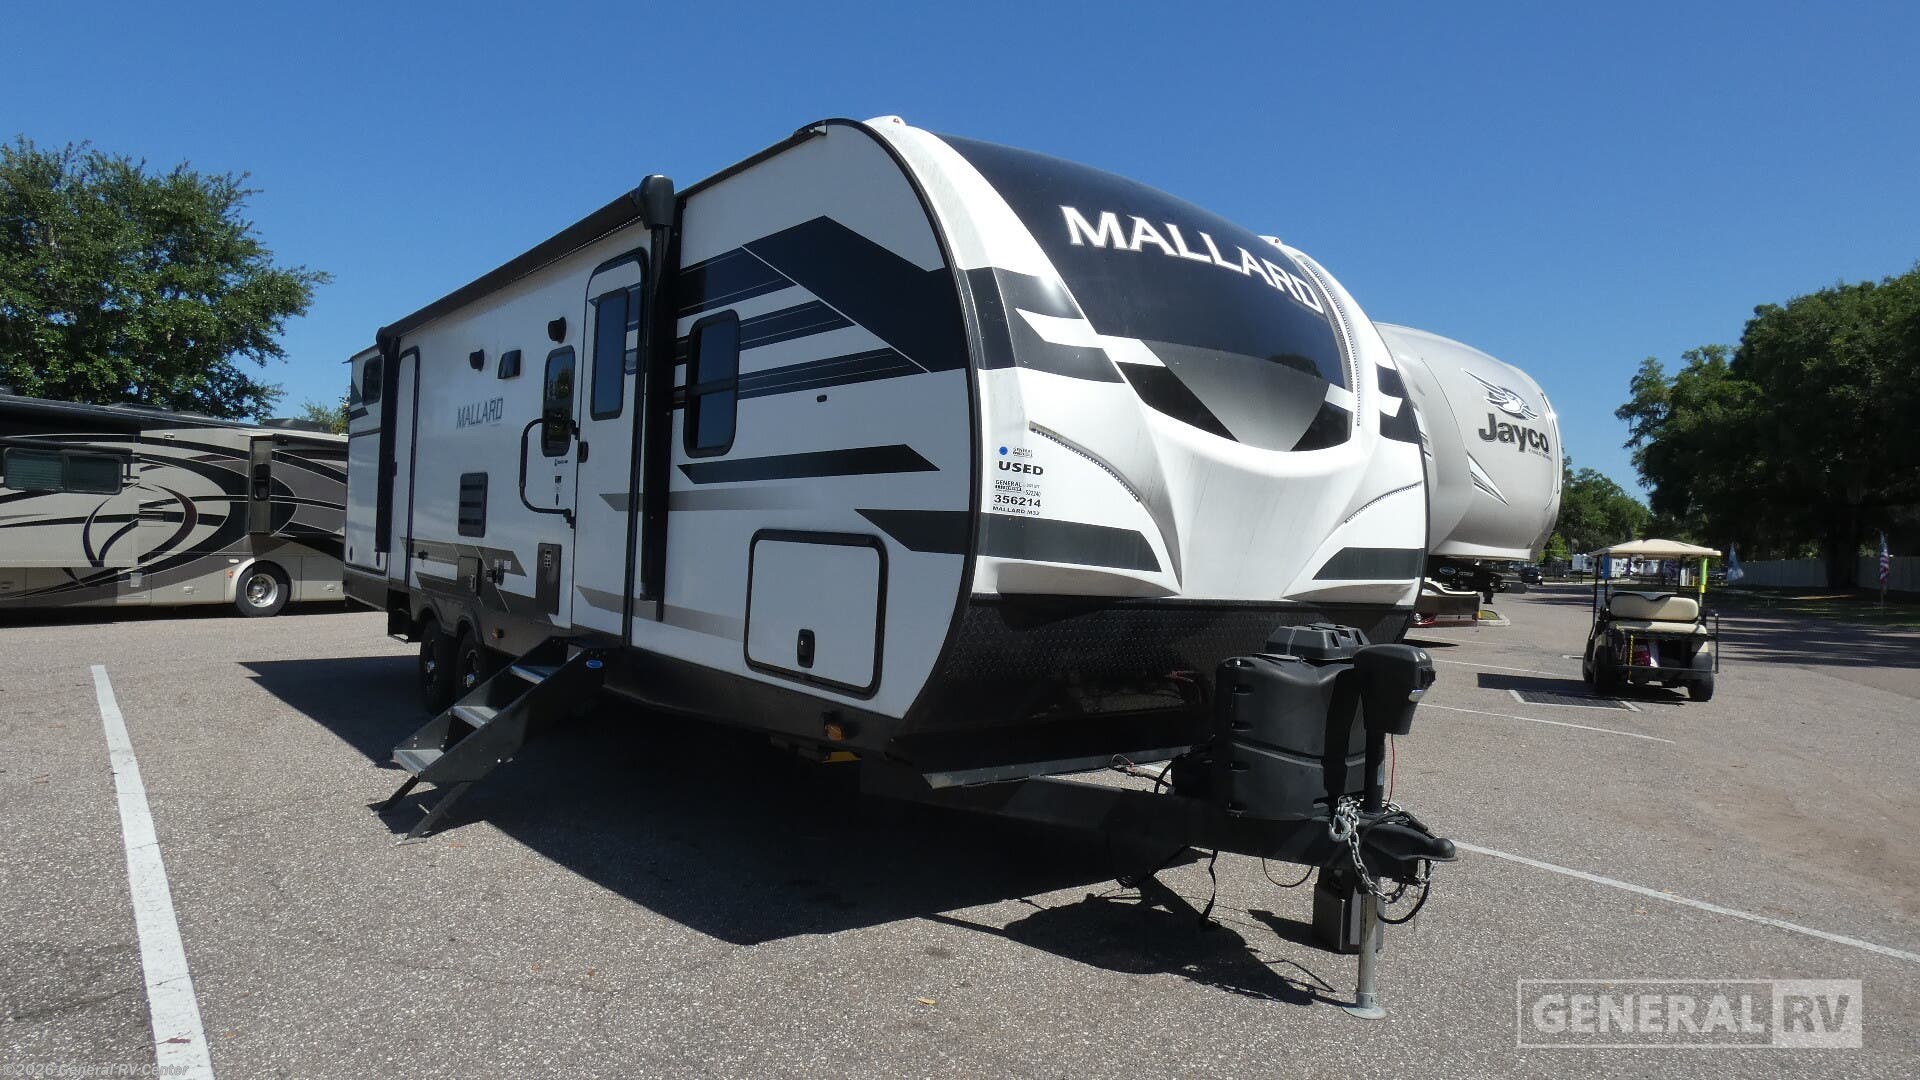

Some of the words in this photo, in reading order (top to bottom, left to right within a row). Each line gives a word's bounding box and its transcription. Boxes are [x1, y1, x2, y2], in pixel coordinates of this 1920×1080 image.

[1058, 204, 1325, 315] MALLARD
[456, 397, 504, 430] MALLARD
[1478, 413, 1550, 453] Jayco
[998, 460, 1044, 476] USED
[992, 505, 1026, 514] MALLARD
[994, 494, 1041, 507] 356214
